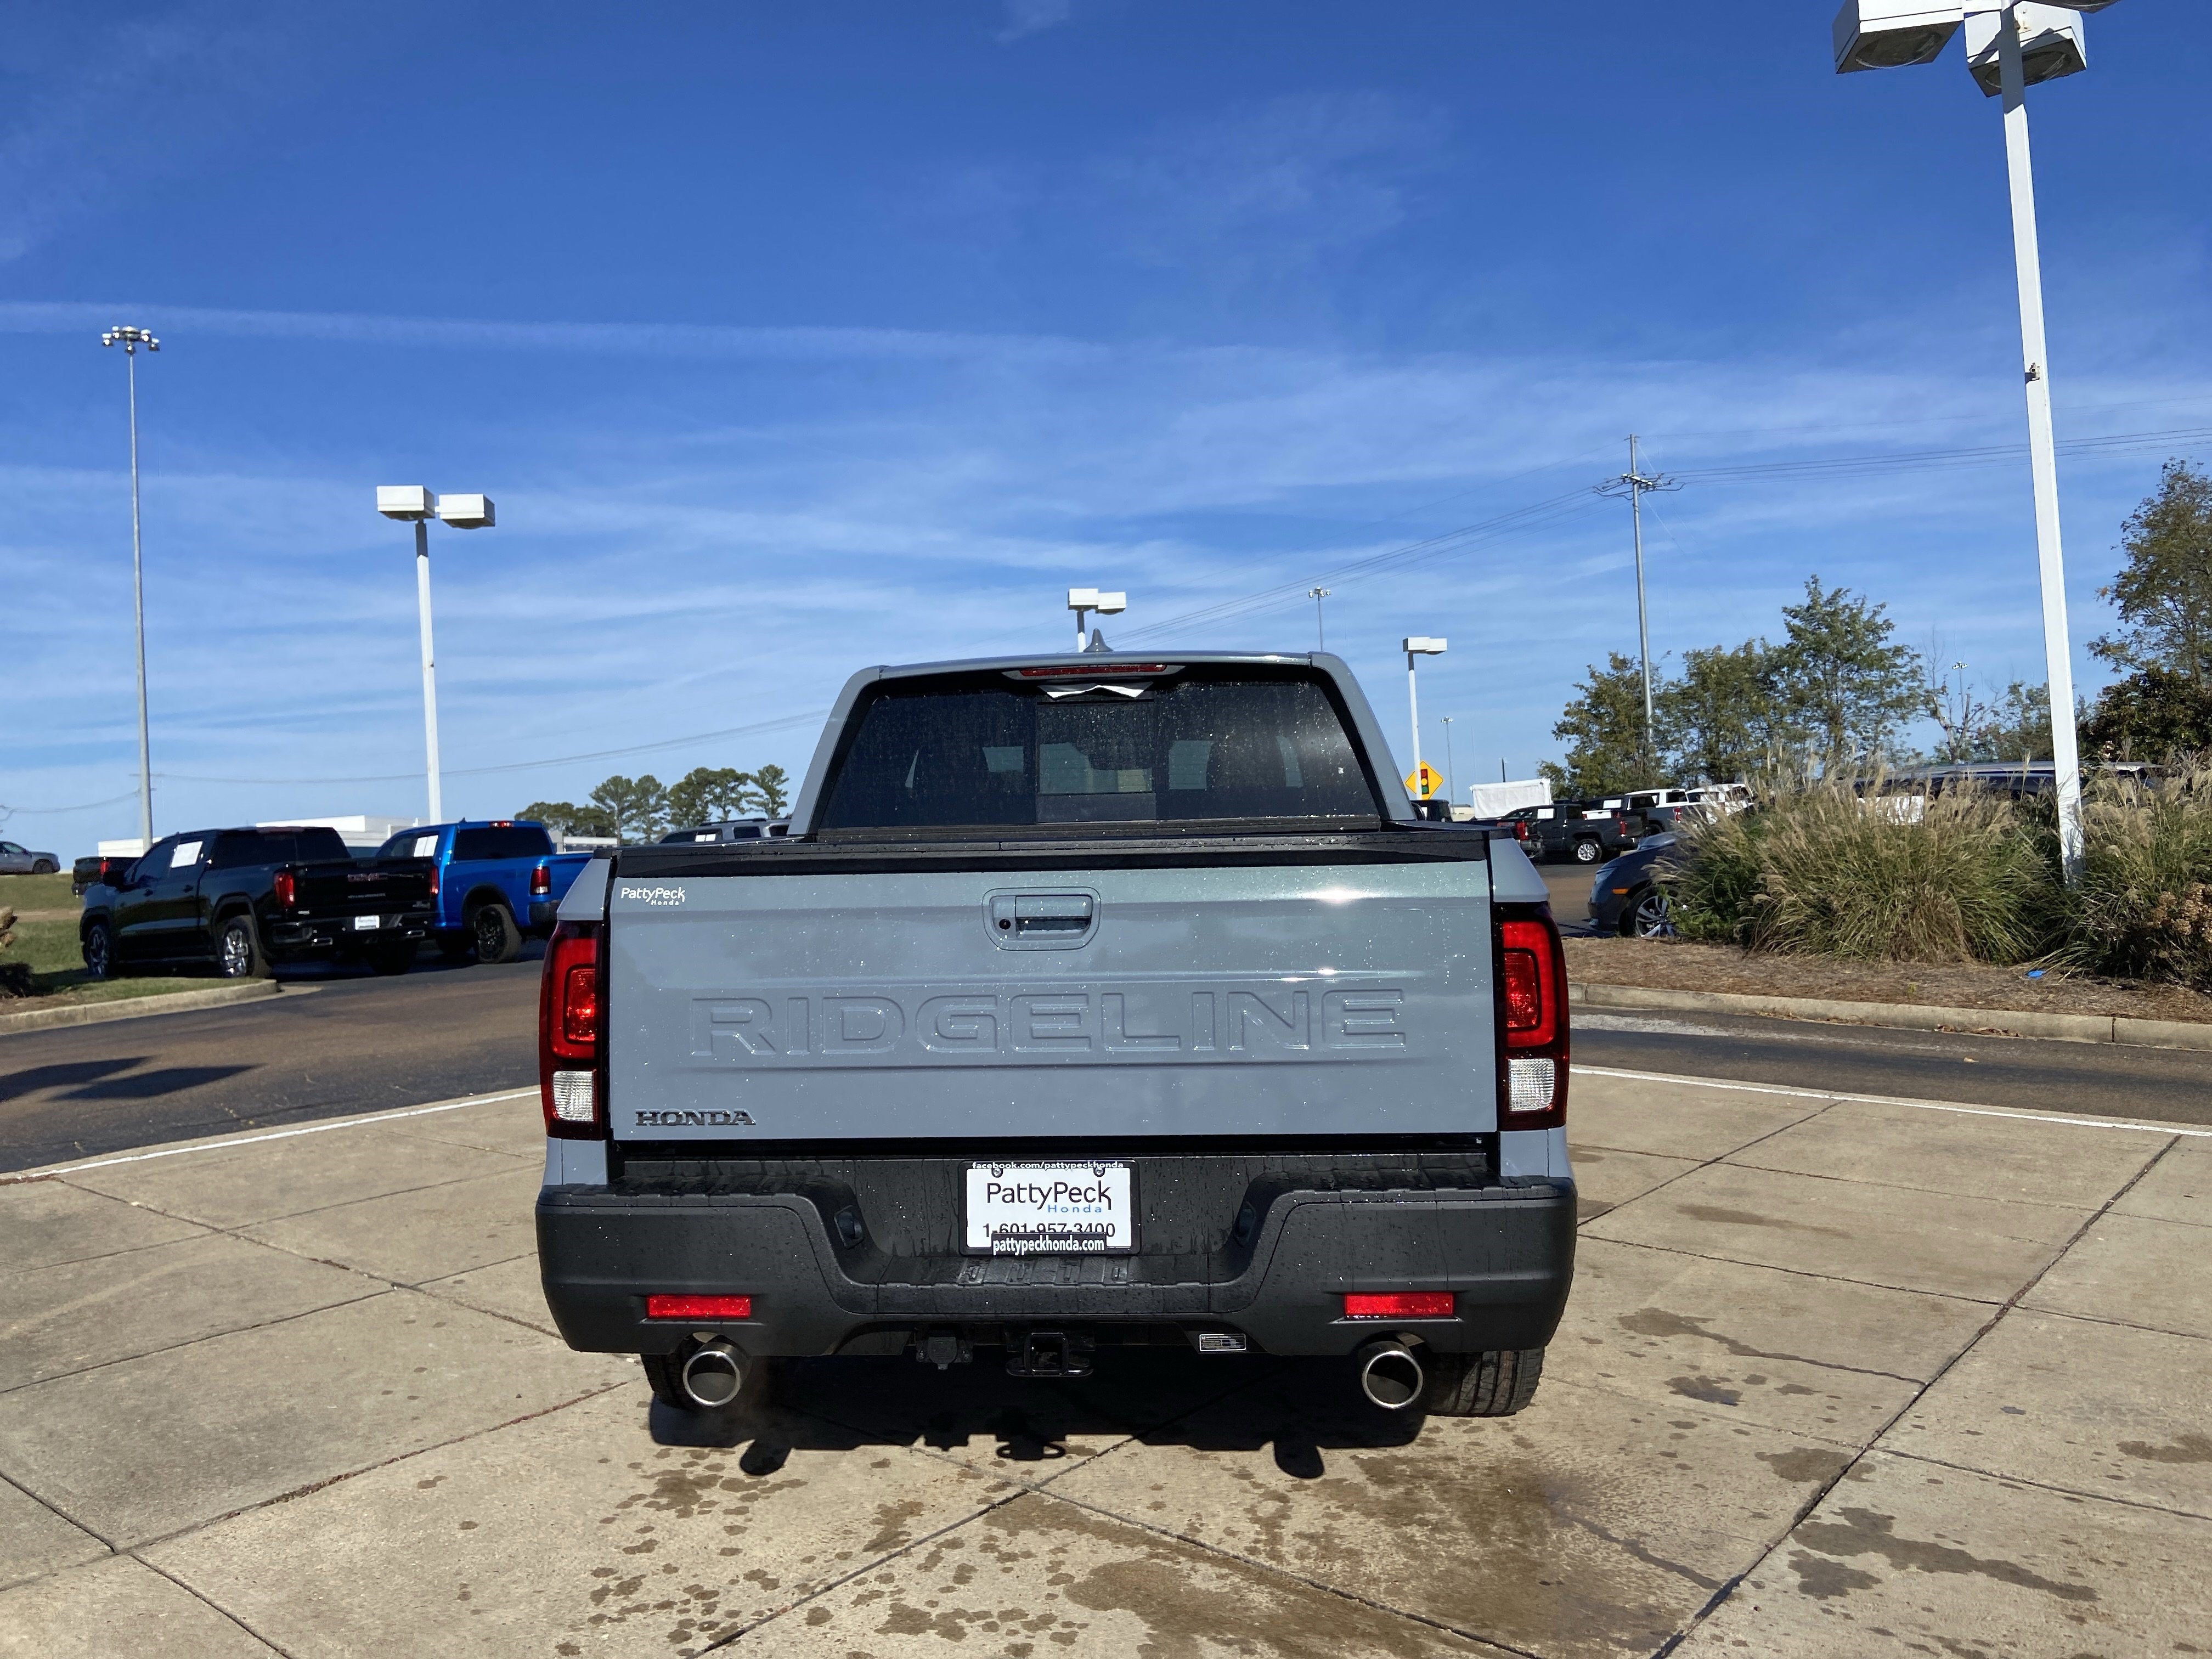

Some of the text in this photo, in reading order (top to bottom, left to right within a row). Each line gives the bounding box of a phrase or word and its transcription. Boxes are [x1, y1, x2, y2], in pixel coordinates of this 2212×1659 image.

[621, 887, 685, 902] PattyPeck
[690, 989, 1406, 1056] RIDGELINE
[635, 1108, 756, 1126] HONDA
[972, 1161, 1124, 1171] facebook.com/pattypeckhonda
[988, 1181, 1111, 1210] PattyPeck
[1047, 1204, 1102, 1212] Honda
[993, 1234, 1104, 1255] pattypeckhonda.com
